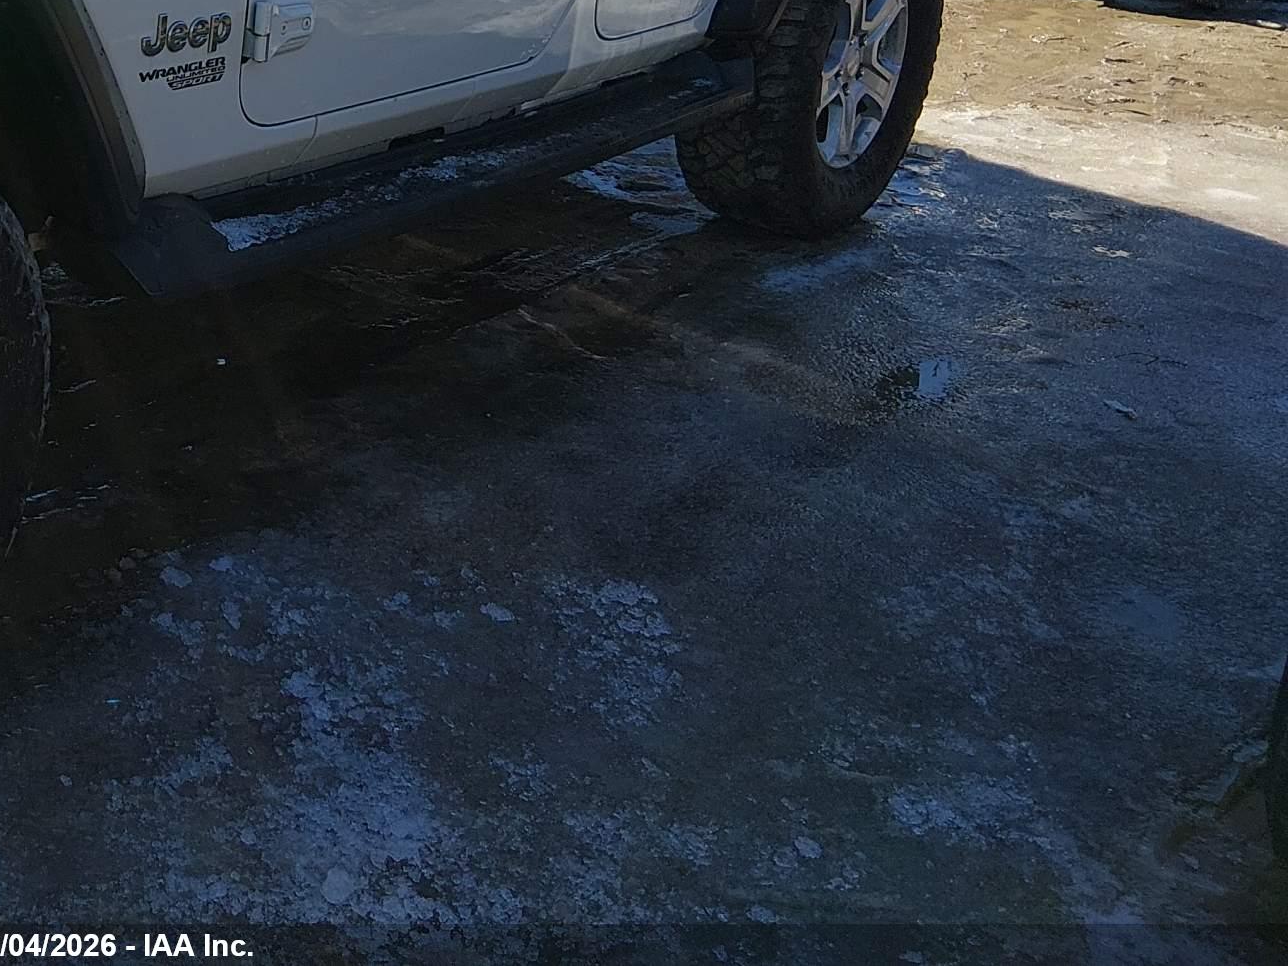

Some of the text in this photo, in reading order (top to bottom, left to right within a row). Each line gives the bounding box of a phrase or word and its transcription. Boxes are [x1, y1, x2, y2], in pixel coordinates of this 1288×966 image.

[140, 13, 232, 57] Jeep
[139, 56, 226, 82] WRANGLER
[166, 65, 226, 82] UNLIMITED
[168, 73, 224, 90] SPORT
